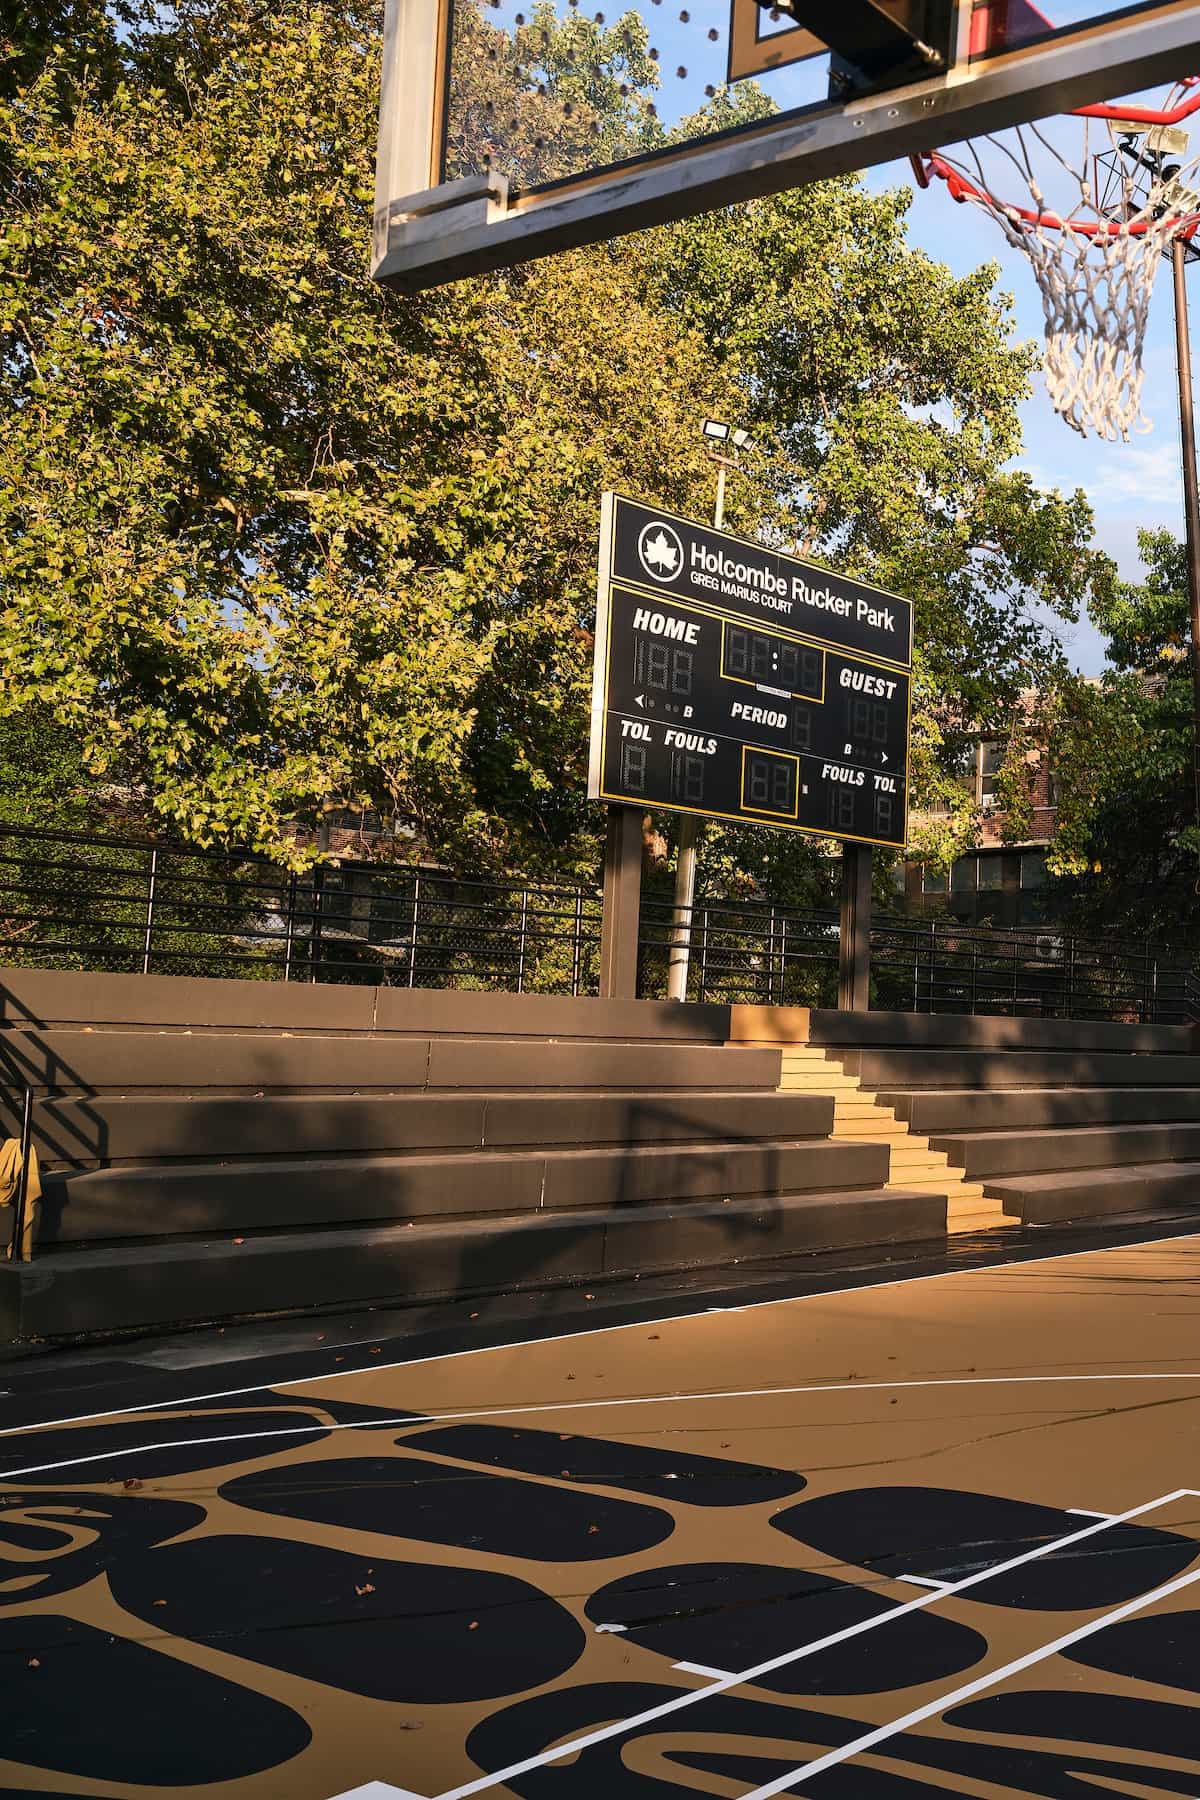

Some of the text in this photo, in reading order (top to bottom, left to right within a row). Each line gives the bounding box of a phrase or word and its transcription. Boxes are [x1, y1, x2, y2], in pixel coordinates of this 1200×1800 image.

[690, 542, 895, 632] Holcombe Rucker Park
[690, 570, 793, 615] GREG MARIUS COURT
[632, 608, 701, 645] HOME
[839, 668, 897, 699] GUEST
[683, 705, 694, 718] B
[731, 702, 788, 729] PERIOD
[621, 719, 718, 755] TOL FOULS
[844, 743, 852, 755] B
[821, 764, 897, 793] FOULS TOL
